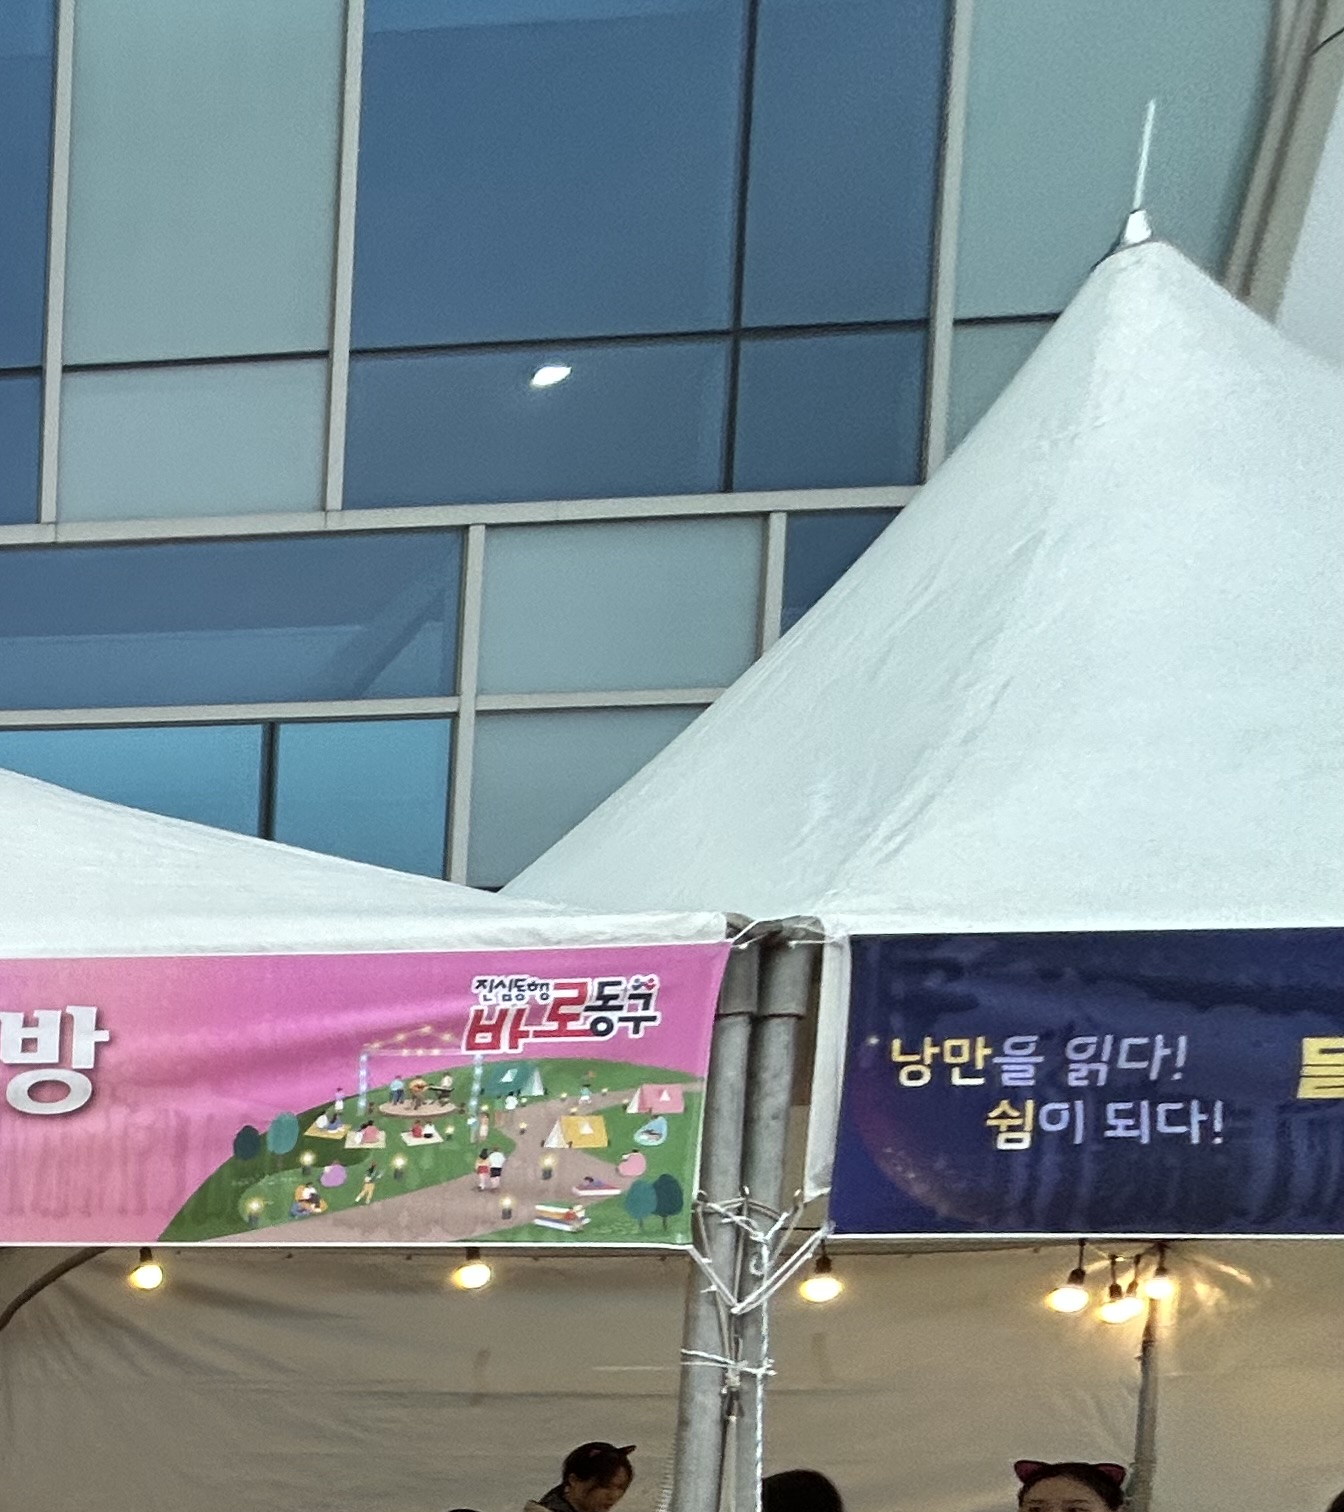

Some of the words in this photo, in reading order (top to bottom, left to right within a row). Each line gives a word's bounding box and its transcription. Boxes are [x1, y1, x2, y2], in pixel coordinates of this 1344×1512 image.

[890, 1035, 1045, 1088] 낭만을
[1064, 1034, 1188, 1087] 읽다!
[985, 1099, 1085, 1152] 쉼이
[1103, 1100, 1224, 1146] 되다!
